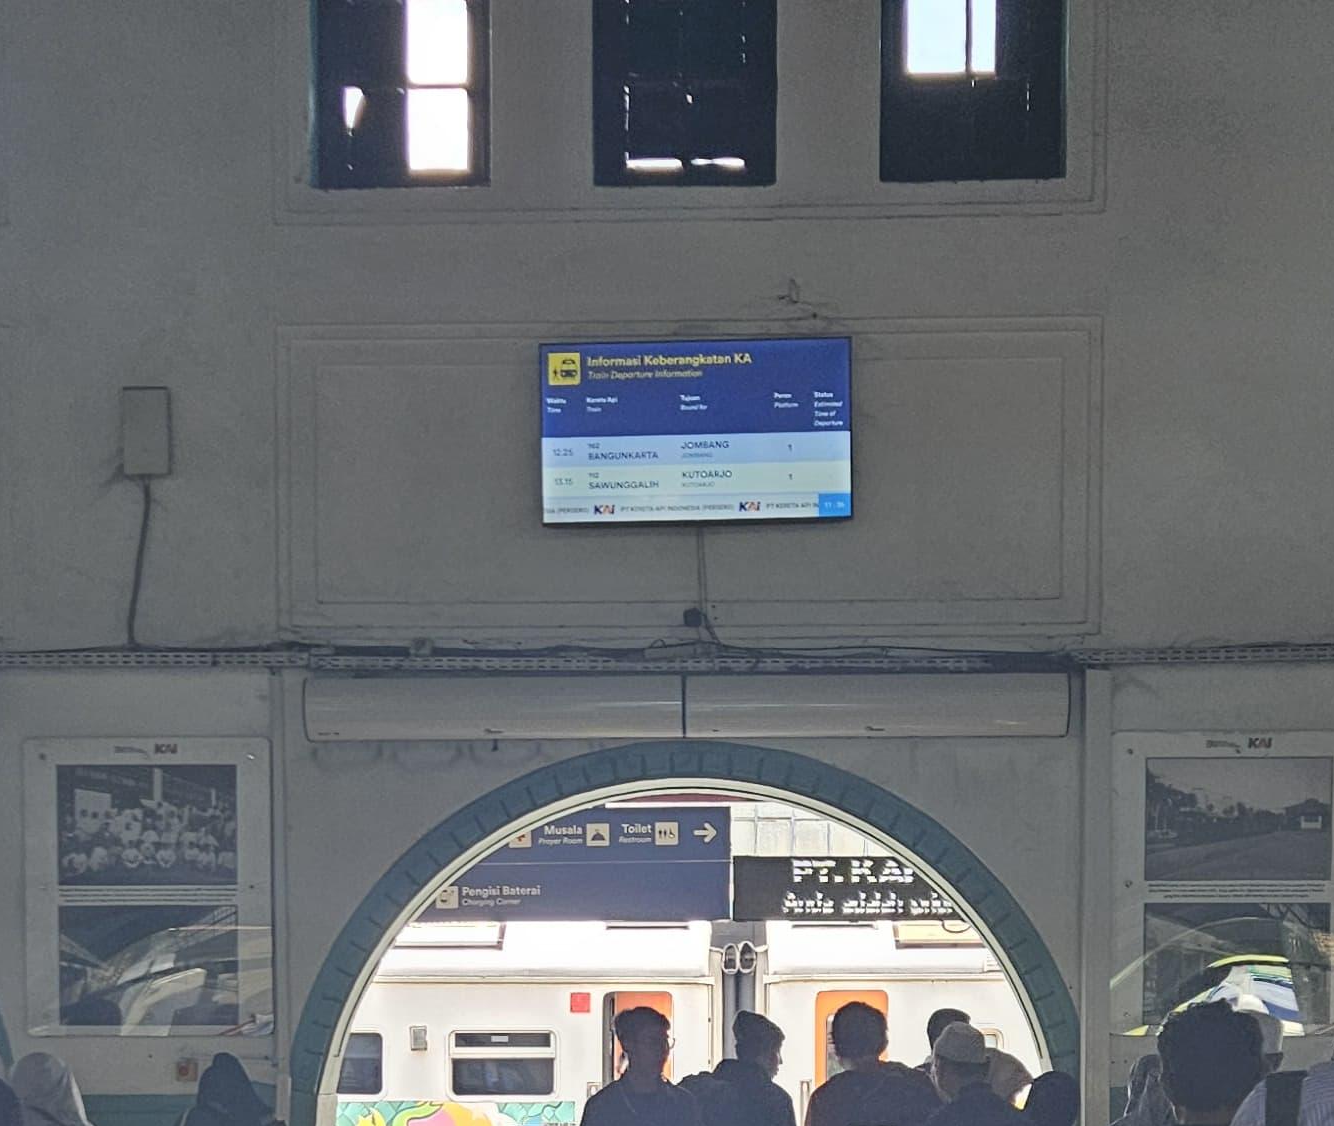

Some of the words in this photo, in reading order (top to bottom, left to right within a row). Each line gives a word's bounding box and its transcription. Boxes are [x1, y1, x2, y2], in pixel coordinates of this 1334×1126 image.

[587, 355, 641, 367] Informasi
[644, 353, 732, 367] Keberangkatan
[734, 353, 753, 364] KA
[610, 370, 654, 380] Departure
[655, 369, 703, 378] Information
[681, 440, 730, 450] JOMBANG
[588, 451, 659, 461] BANGUNKARTA
[682, 469, 733, 480] KUTOARJO
[589, 480, 659, 490] SAWUNGGALIH
[544, 824, 583, 836] Musala
[621, 823, 652, 835] Toilet
[562, 836, 583, 845] Room
[619, 836, 652, 844] Restroom
[462, 886, 500, 897] Pengisi
[502, 885, 541, 896] Baterai
